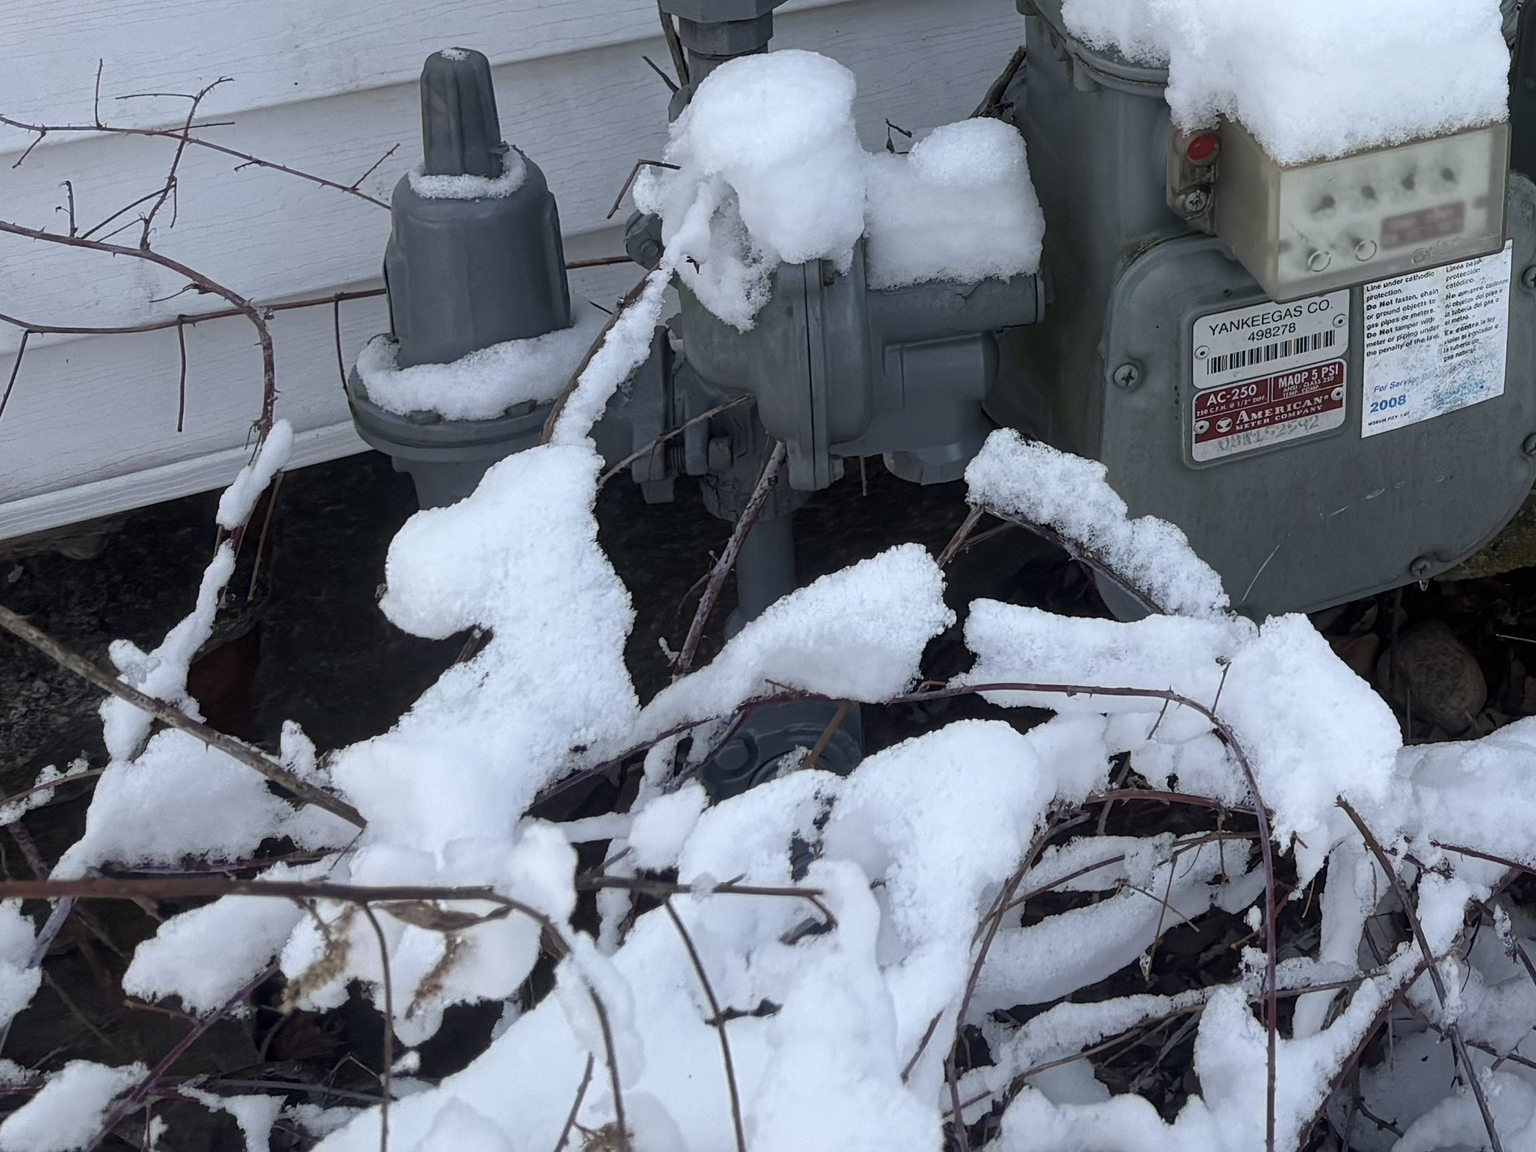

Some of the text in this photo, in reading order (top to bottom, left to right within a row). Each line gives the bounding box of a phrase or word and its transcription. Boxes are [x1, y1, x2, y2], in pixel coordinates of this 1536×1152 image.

[1383, 278, 1403, 288] under
[1405, 271, 1434, 282] cathodic
[1380, 299, 1393, 307] Not
[1421, 288, 1439, 298] chain
[1209, 299, 1333, 336] YANKEEGAS CO.
[1376, 307, 1400, 319] ground
[1402, 300, 1426, 312] objects
[1381, 316, 1399, 327] pipes
[1395, 321, 1419, 331] tamper
[1248, 322, 1296, 342] 498278
[1366, 340, 1386, 348] meter
[1396, 331, 1418, 342] piping
[1420, 324, 1440, 334] under
[1366, 349, 1377, 357] the
[1406, 339, 1412, 347] of
[1414, 336, 1425, 344] the
[1278, 364, 1339, 389] MAOP 5 PSI
[1207, 384, 1257, 406] AC-250
[1374, 385, 1387, 393] For
[1236, 396, 1324, 424] AMERICAN
[1370, 394, 1406, 413] 2008
[1235, 405, 1323, 431] METER COMPANY
